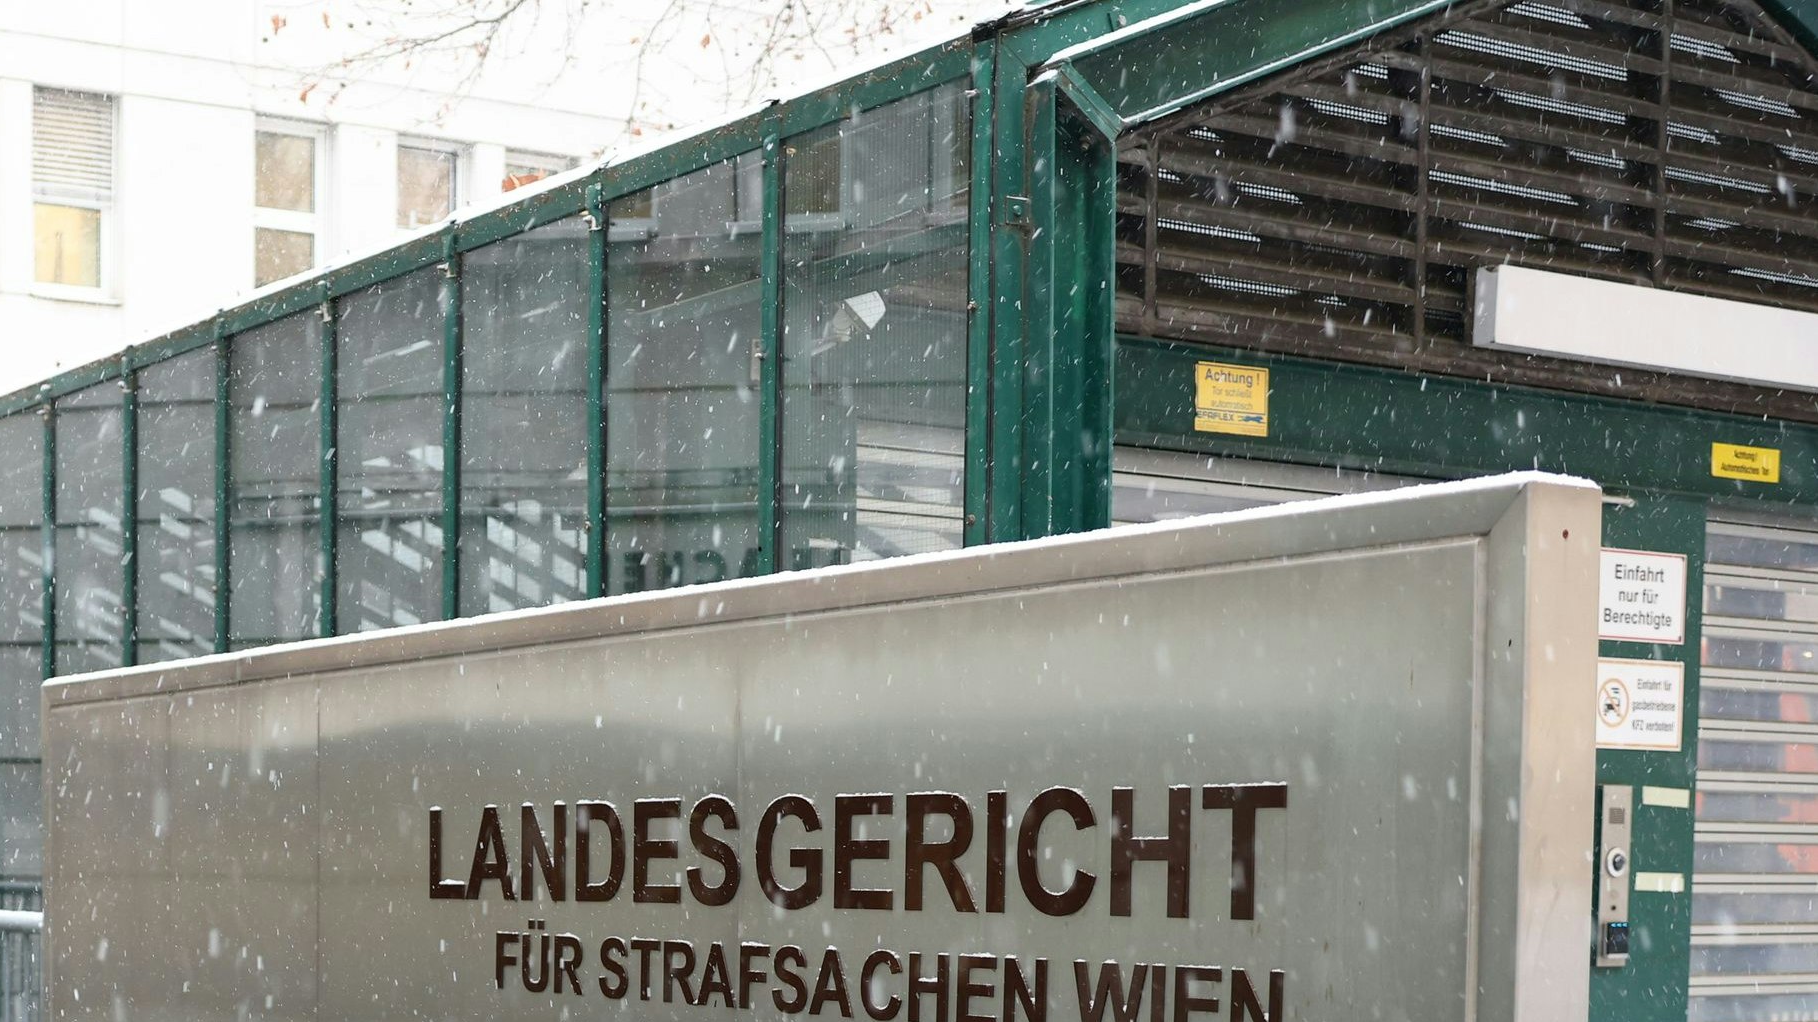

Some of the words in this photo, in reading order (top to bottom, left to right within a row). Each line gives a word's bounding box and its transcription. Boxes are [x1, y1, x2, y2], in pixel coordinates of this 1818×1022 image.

[1205, 368, 1253, 388] Achtung
[1615, 564, 1664, 583] Einfahrt
[1618, 590, 1639, 602] nur
[1642, 588, 1659, 604] für
[1603, 607, 1672, 630] Berechtigte
[430, 782, 1288, 920] LANDESGERICHT
[495, 919, 583, 996] FÜR
